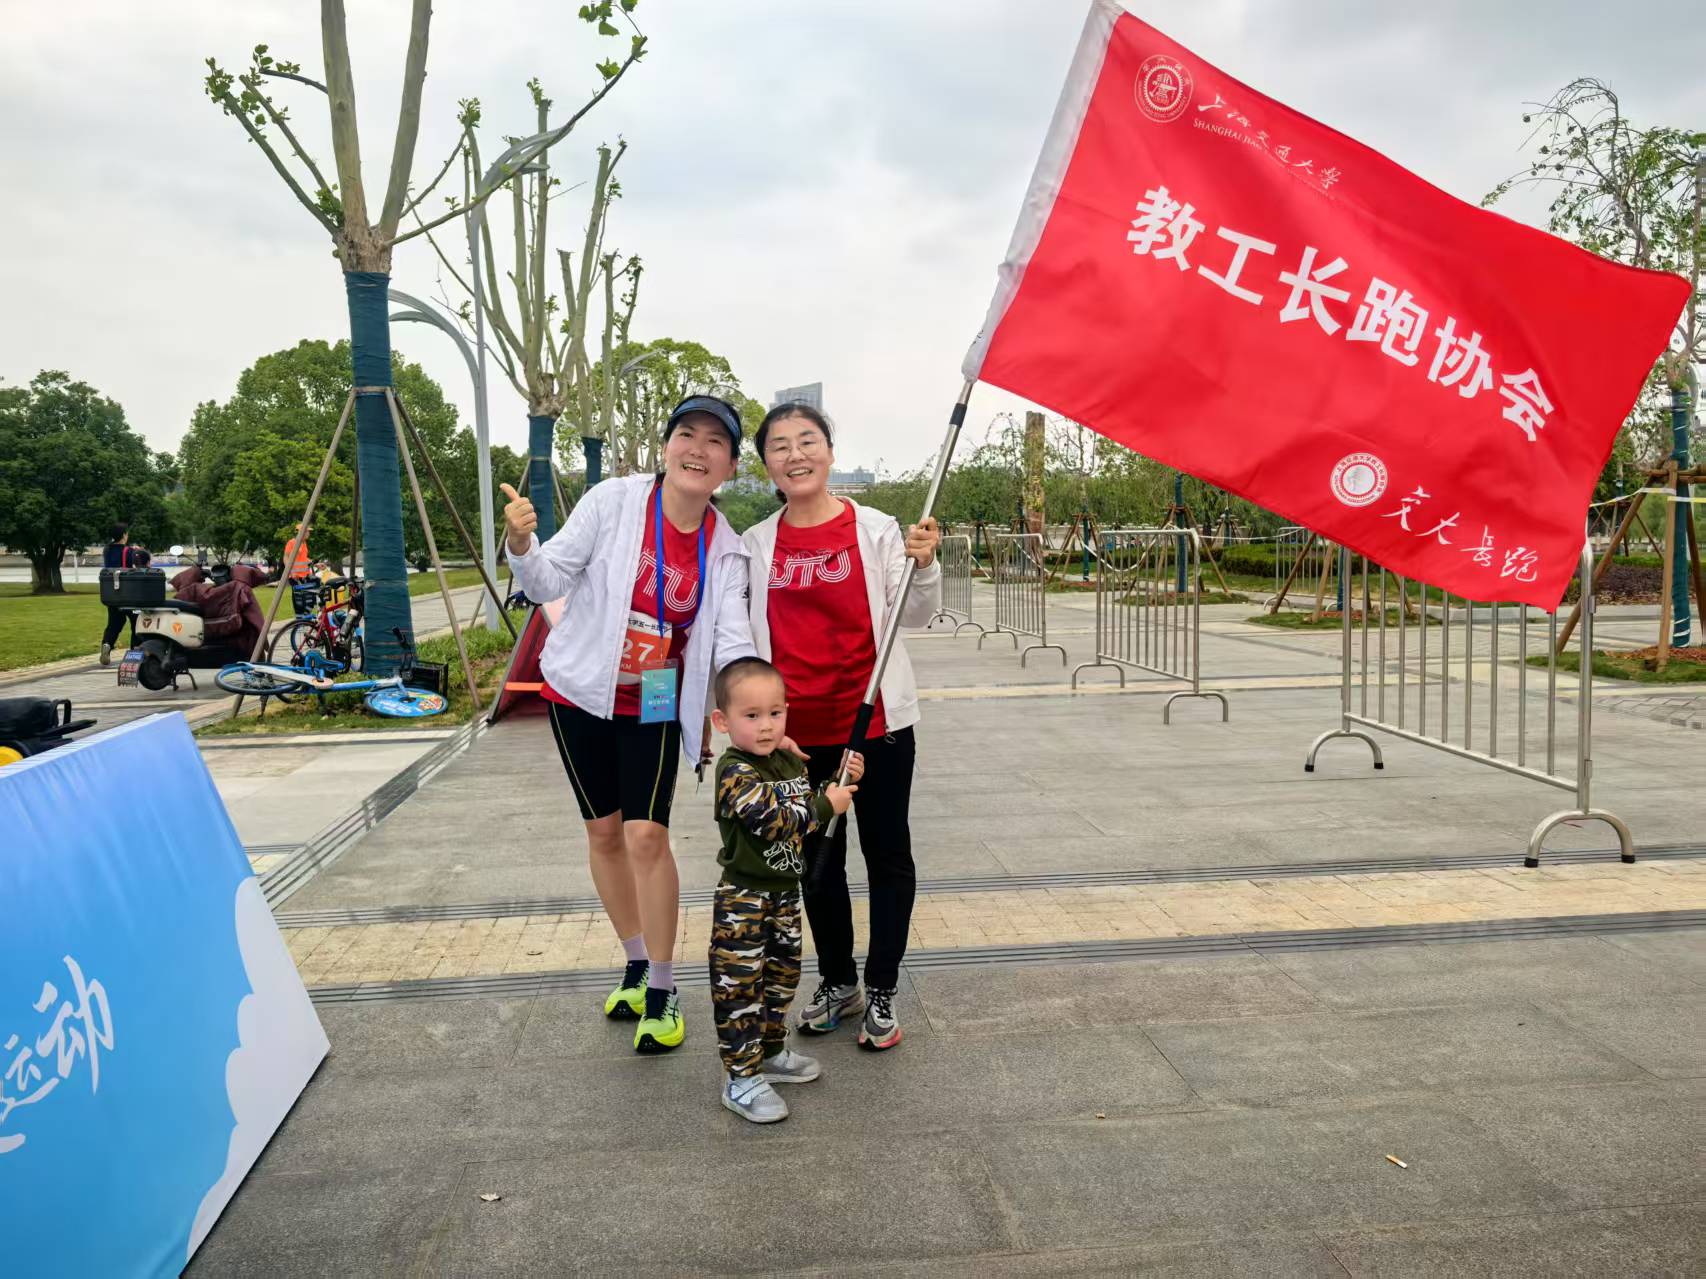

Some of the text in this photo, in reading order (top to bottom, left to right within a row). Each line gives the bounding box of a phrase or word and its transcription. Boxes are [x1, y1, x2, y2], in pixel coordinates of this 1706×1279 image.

[1193, 117, 1242, 141] SHANGHAI
[1126, 185, 1555, 442] 教工长跑协会
[623, 638, 655, 663] 27
